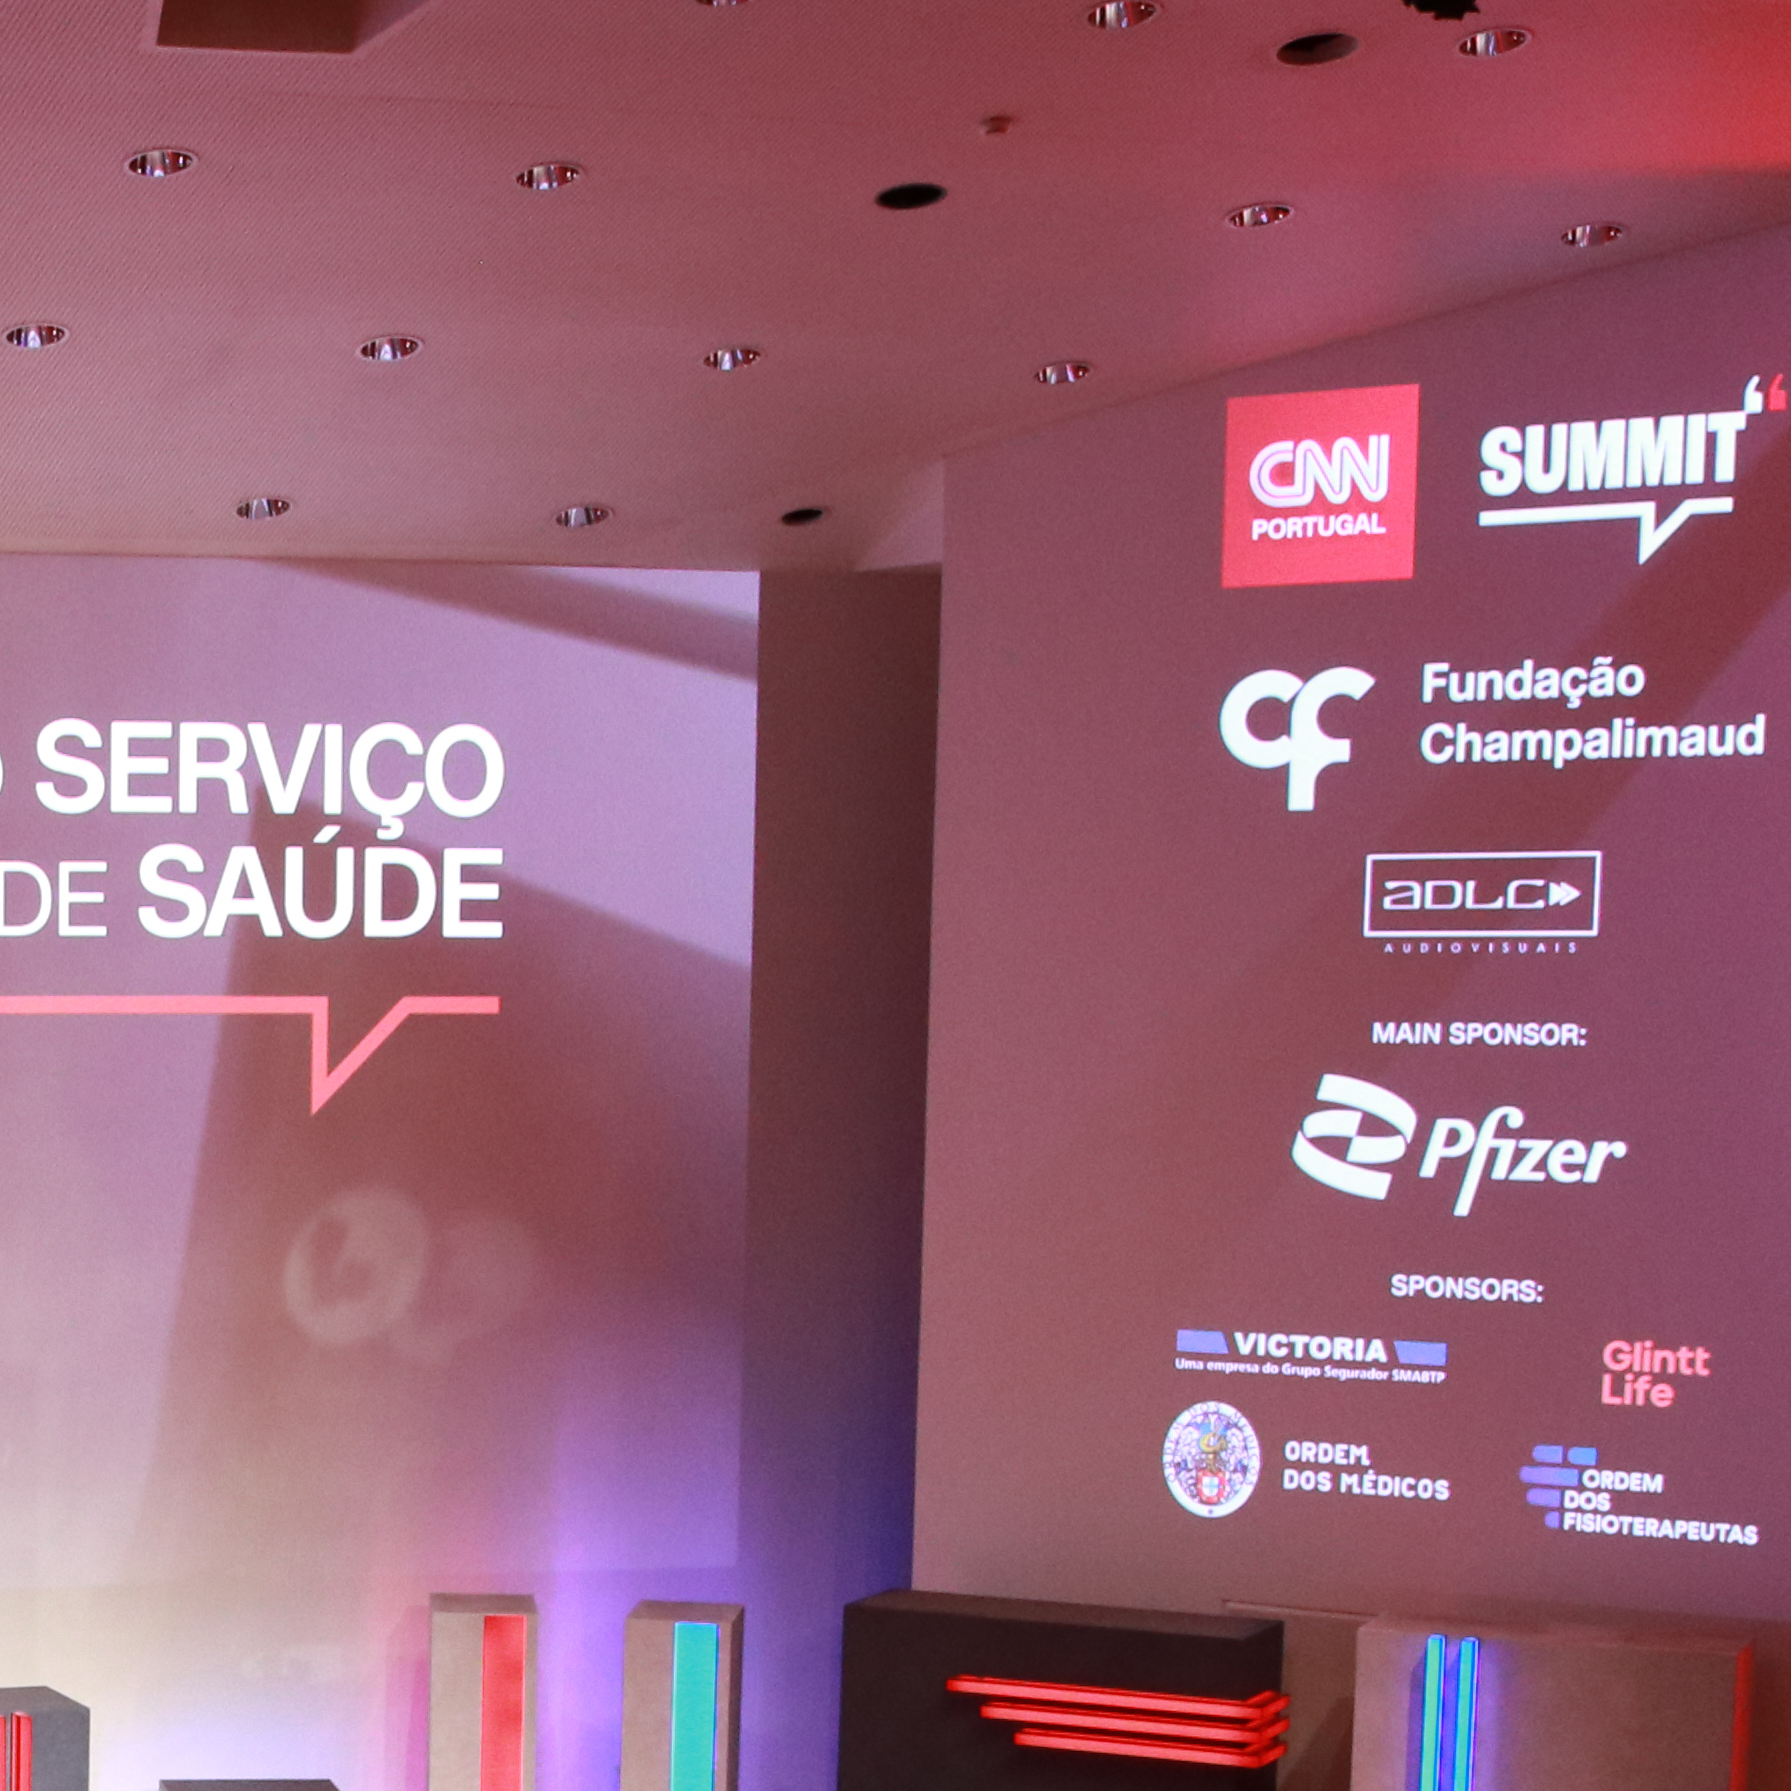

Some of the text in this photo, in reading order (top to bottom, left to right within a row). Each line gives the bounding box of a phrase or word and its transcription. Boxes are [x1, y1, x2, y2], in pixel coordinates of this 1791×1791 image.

[1249, 435, 1390, 507] CNN
[1252, 513, 1386, 540] PORTUGAL
[1421, 656, 1645, 709] Fundação
[1420, 713, 1767, 768] Champalimaud
[35, 717, 504, 840] SERVIÇO
[137, 825, 504, 939] SAÚDE
[1384, 942, 1577, 953] AUDIOVISUAIS
[1372, 1022, 1587, 1047] MAIN SPONSOR:
[1419, 1106, 1627, 1216] Pfizer
[1390, 1274, 1545, 1303] SPONSORS:
[1233, 1331, 1389, 1363] VICTORIA
[1602, 1340, 1712, 1376] Glintt
[1175, 1358, 1204, 1370] Uma
[1207, 1361, 1259, 1375] empresa
[1262, 1362, 1279, 1374] do
[1281, 1364, 1322, 1378] Grupo
[1324, 1366, 1389, 1381] Segurador
[1600, 1373, 1676, 1408] Life
[1284, 1441, 1371, 1466] ORDEM
[1283, 1469, 1452, 1501] DOS MÉDICOS
[1581, 1469, 1665, 1494] ORDEM
[1563, 1490, 1612, 1512] DOS
[1563, 1512, 1760, 1546] FISIOTERAPEUTAS
